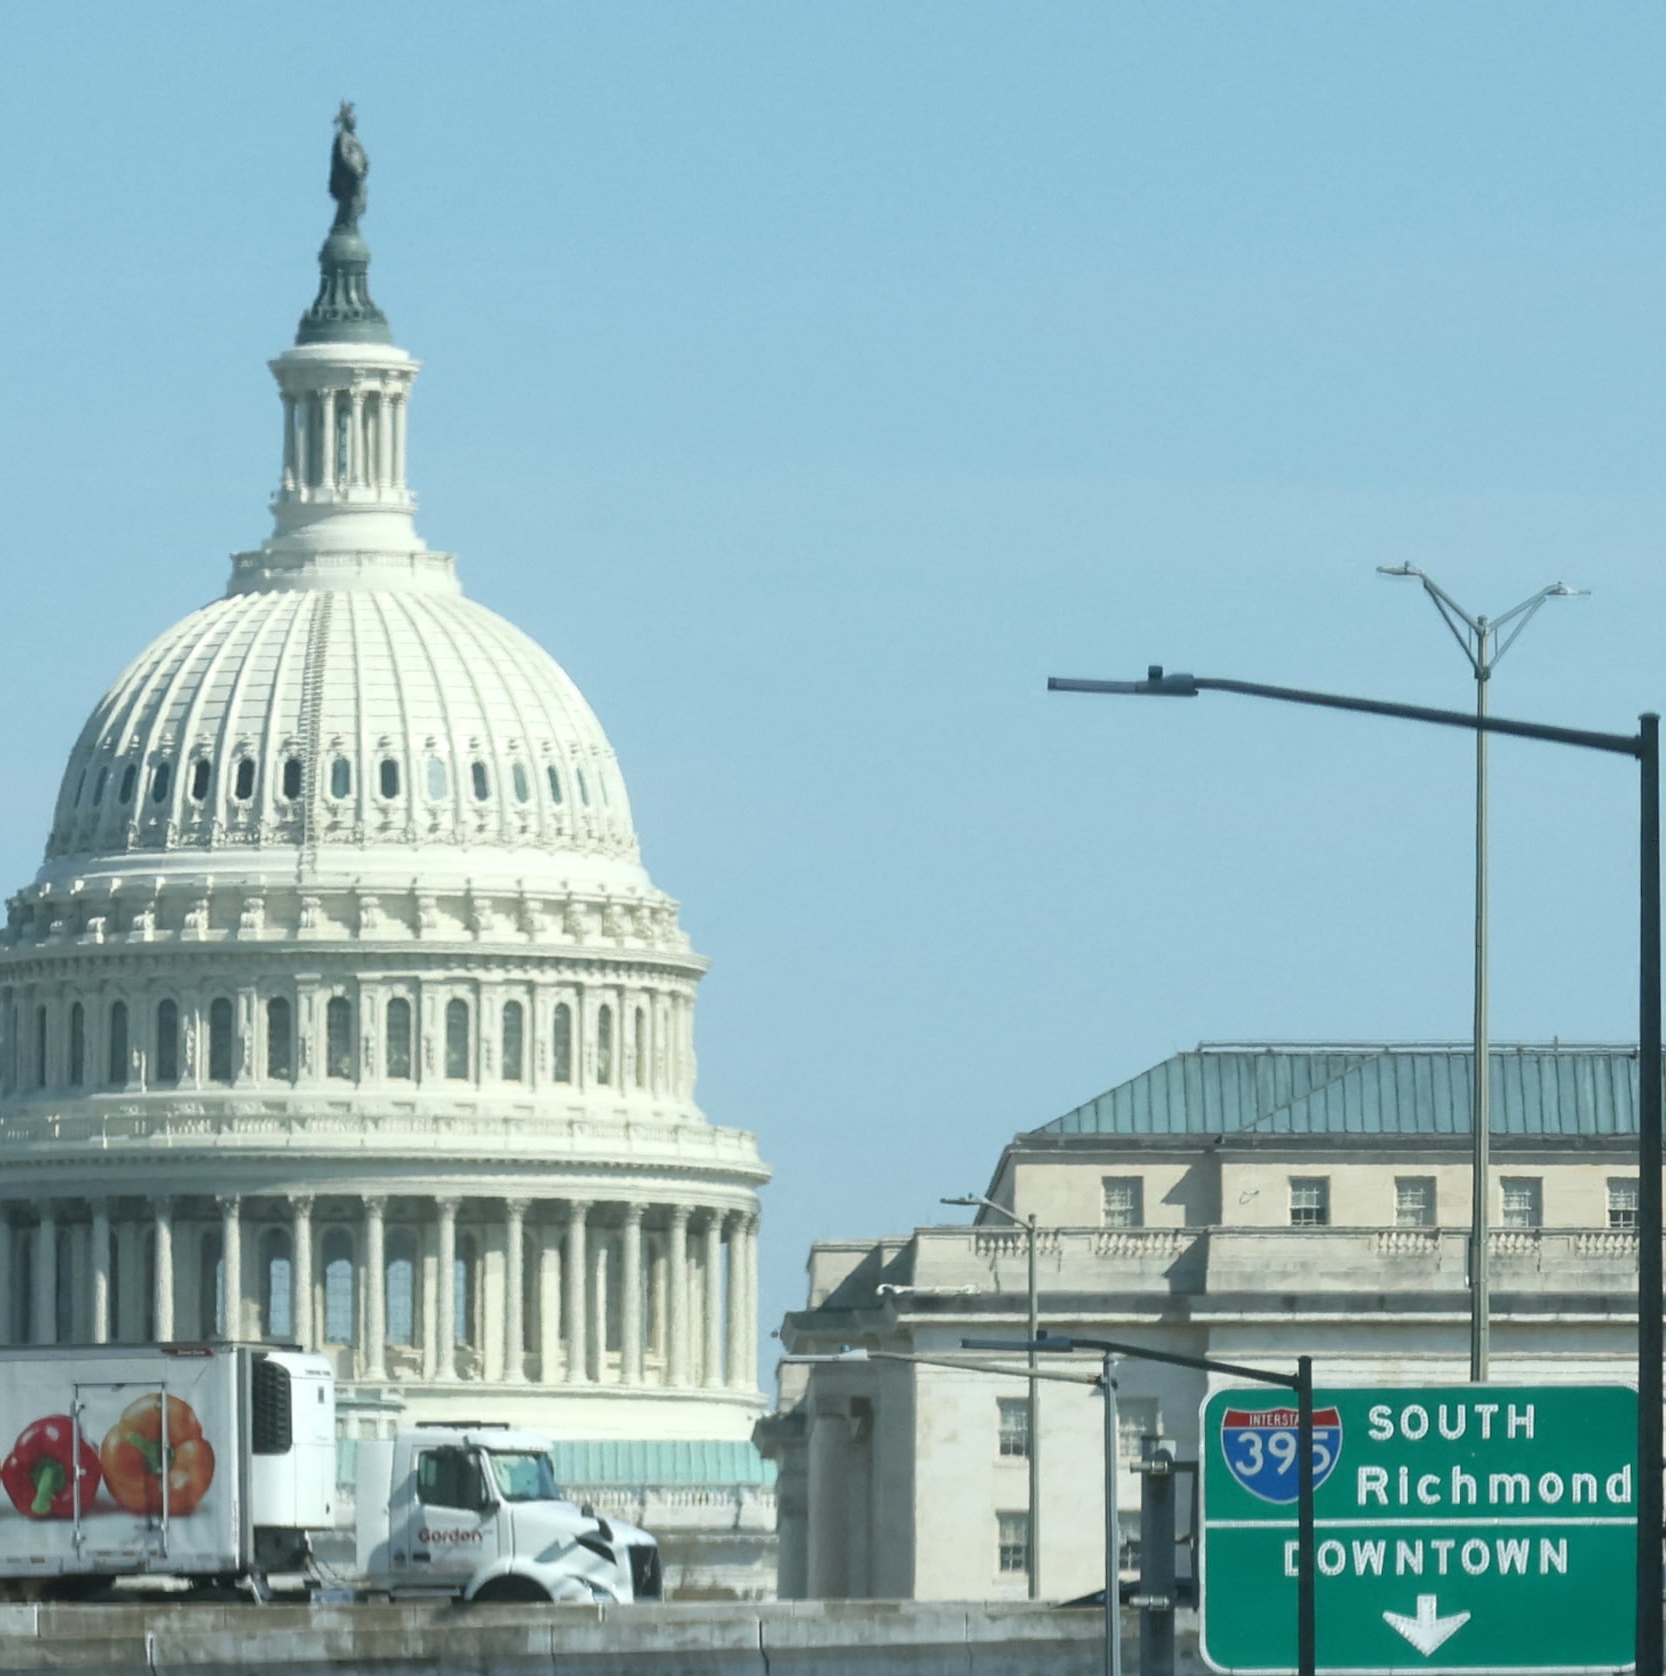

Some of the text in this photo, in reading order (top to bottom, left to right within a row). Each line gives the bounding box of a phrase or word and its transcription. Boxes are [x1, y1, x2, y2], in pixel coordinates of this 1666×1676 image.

[1249, 1413, 1299, 1427] INTERSTA
[1368, 1403, 1534, 1440] SOUTH
[1235, 1431, 1331, 1477] 395
[1356, 1463, 1632, 1506] Richmond
[418, 1527, 482, 1544] Gordon
